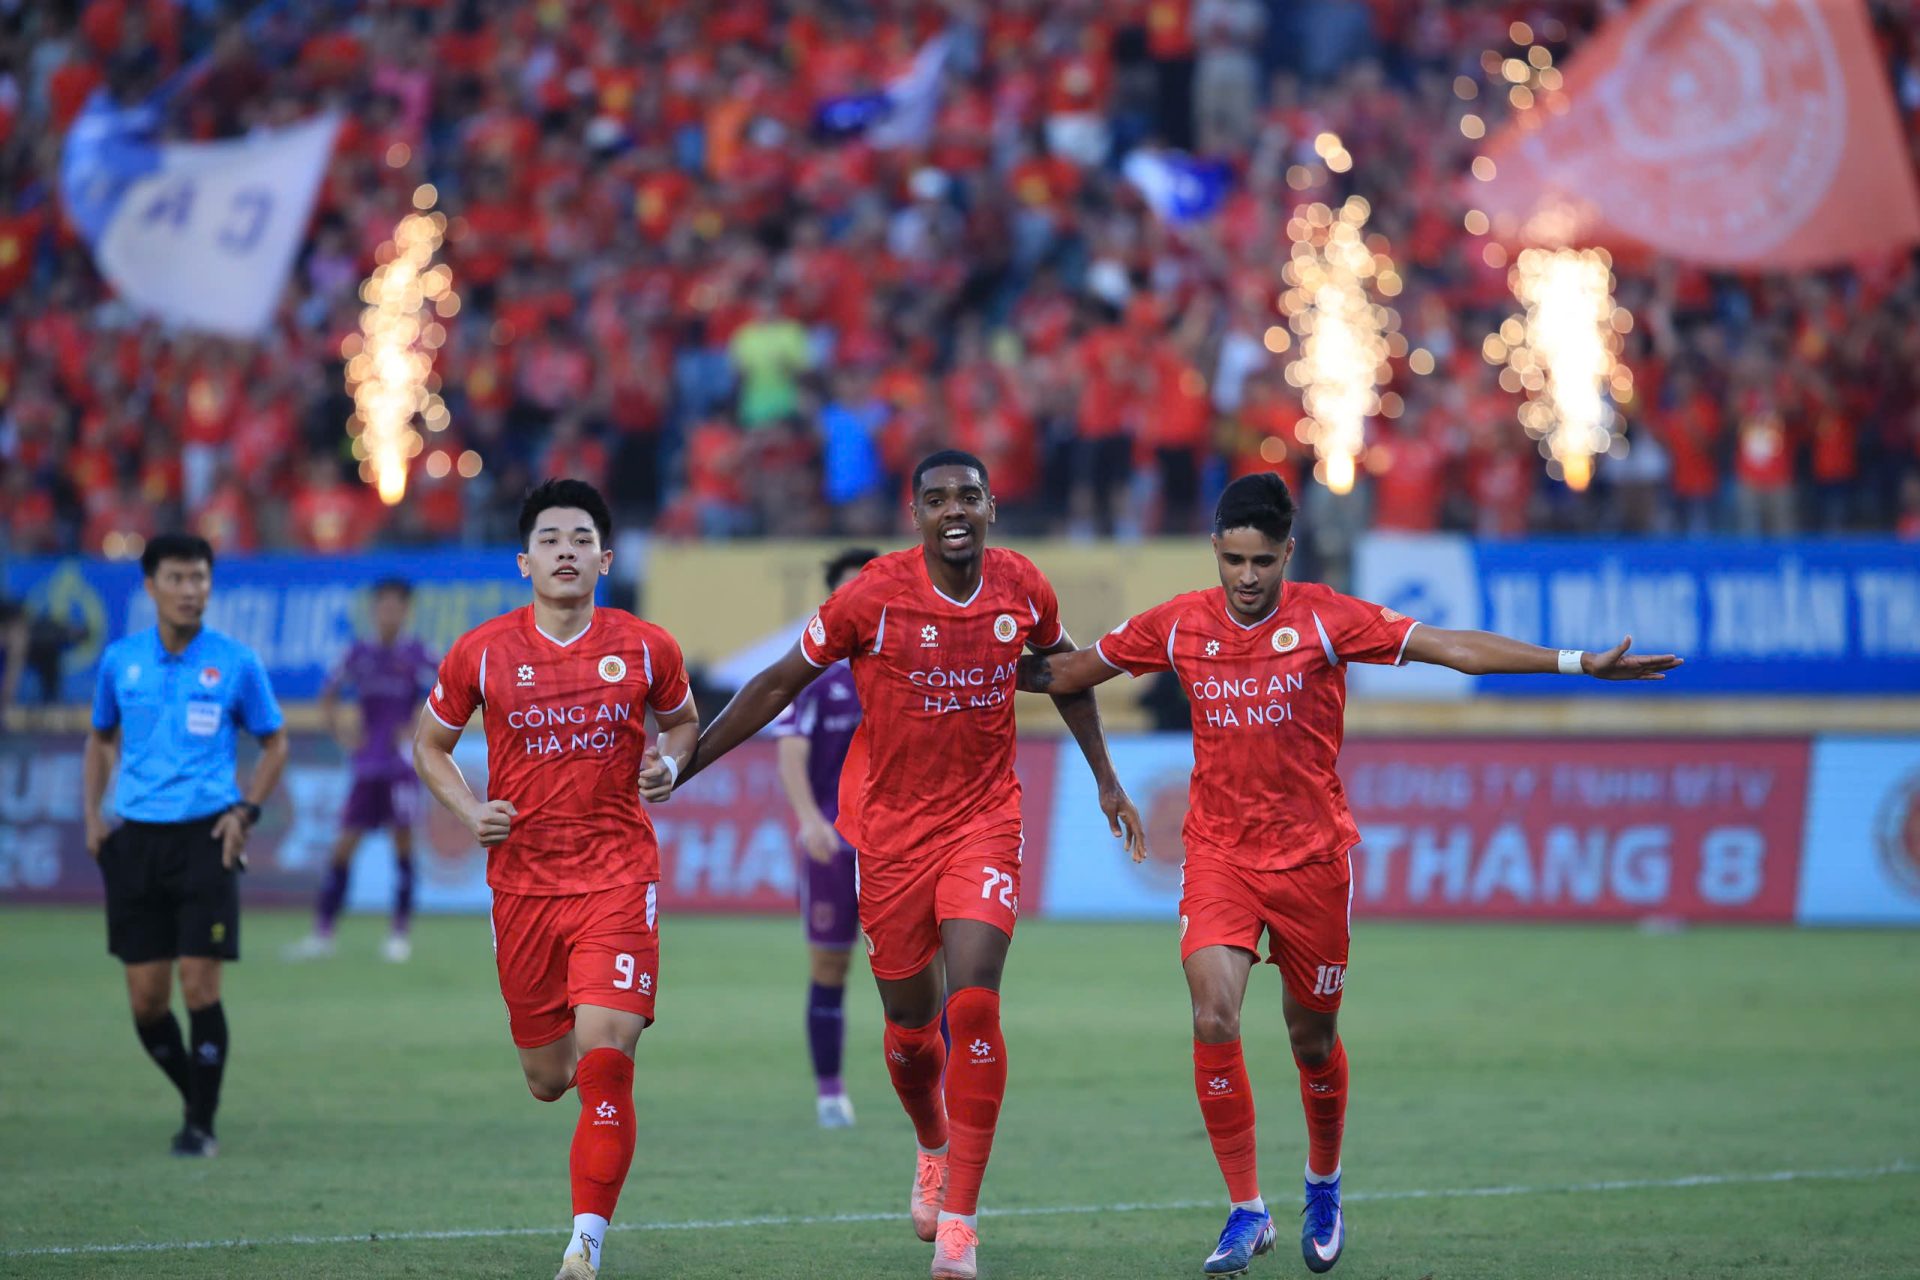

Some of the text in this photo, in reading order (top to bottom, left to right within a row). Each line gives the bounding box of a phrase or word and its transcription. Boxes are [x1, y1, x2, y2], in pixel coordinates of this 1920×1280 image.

[908, 658, 1018, 688] CÔNG AN
[1193, 672, 1303, 700] CÔNG AN
[508, 703, 630, 729] CÔNG AN
[924, 692, 961, 713] HÀ
[1206, 698, 1292, 727] HÀ NỘI
[525, 726, 615, 755] HÀ NỘI
[1699, 824, 1766, 906] 8
[982, 866, 1012, 910] 72
[613, 953, 635, 989] 9
[1313, 965, 1341, 995] 10
